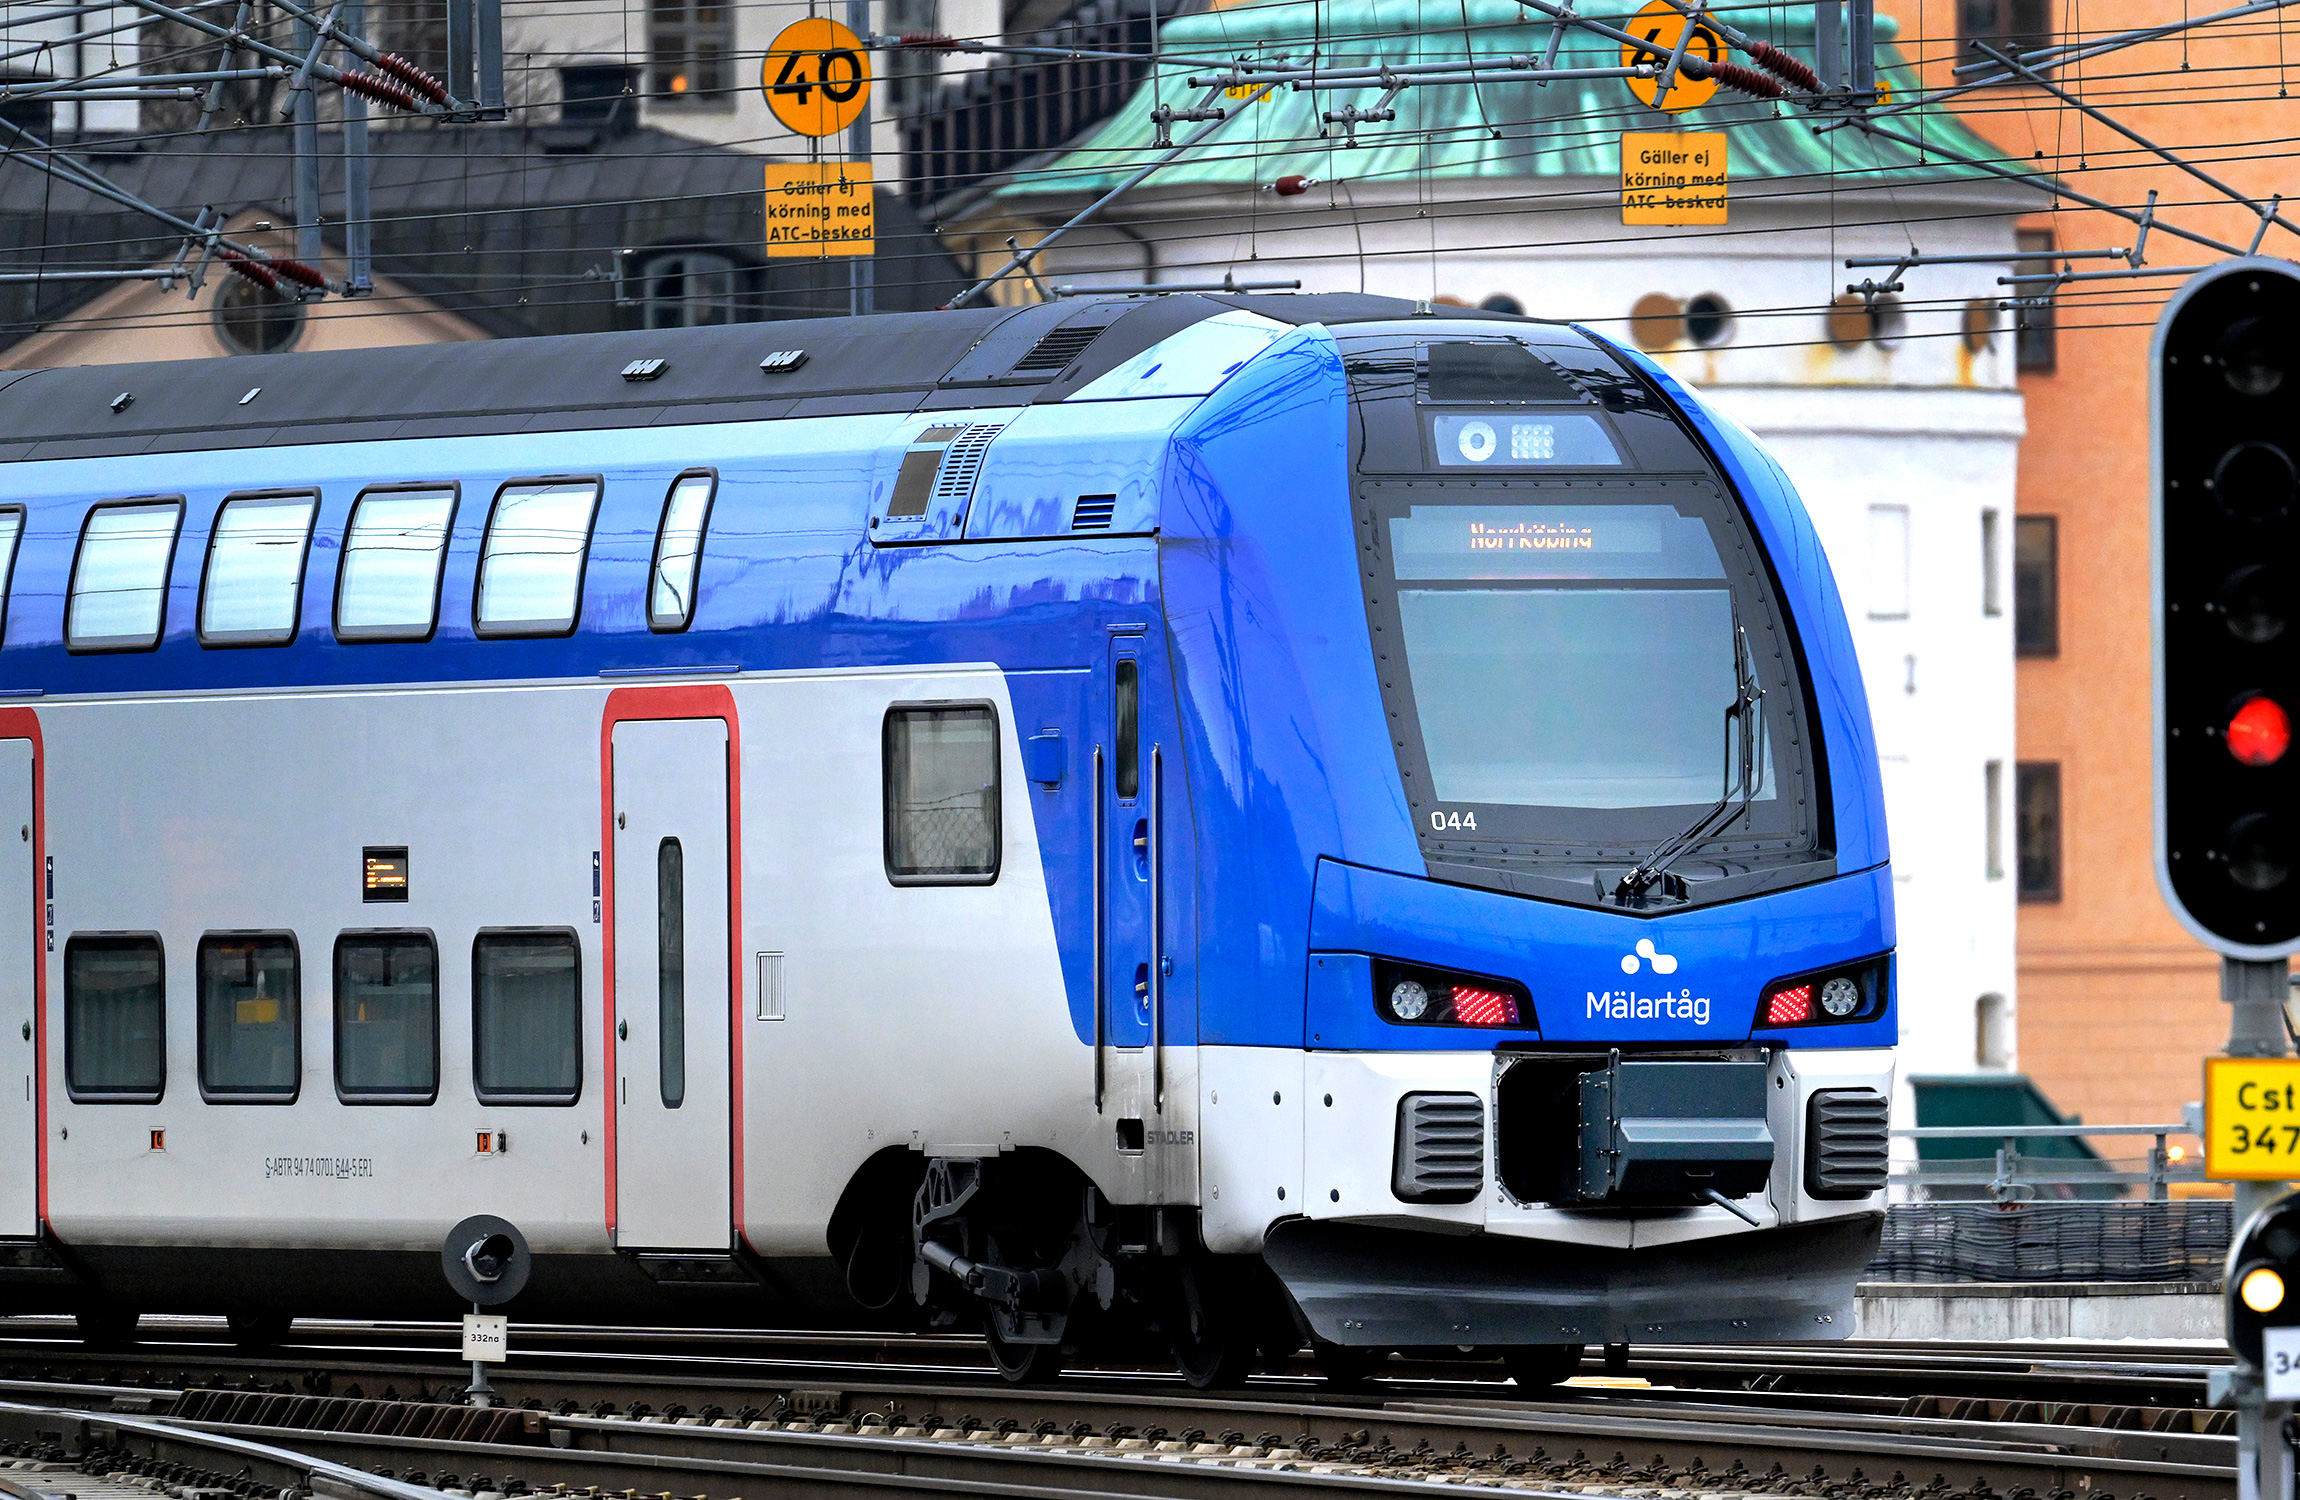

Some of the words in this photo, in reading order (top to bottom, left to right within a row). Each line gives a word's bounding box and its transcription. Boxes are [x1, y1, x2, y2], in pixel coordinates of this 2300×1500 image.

[773, 47, 862, 105] 40
[1640, 149, 1689, 164] Gäller
[1694, 149, 1709, 167] ej
[784, 181, 833, 195] Gäller
[839, 179, 854, 197] ej
[1625, 172, 1685, 190] körning
[1692, 172, 1725, 186] med
[768, 203, 830, 220] körning
[837, 202, 870, 217] med
[1626, 195, 1725, 209] ATCbesked
[770, 225, 871, 241] ATC-besked
[1470, 523, 1592, 548] Norrköping
[1430, 811, 1477, 831] 044
[1586, 988, 1710, 1026] Mälartåg
[2238, 1082, 2294, 1111] Cst
[1147, 1131, 1195, 1145] STADLER
[2231, 1124, 2300, 1154] 347
[294, 1158, 303, 1176] 94
[305, 1158, 314, 1176] 74
[315, 1158, 334, 1177] 0701
[335, 1158, 357, 1179] 644-5
[471, 1334, 499, 1342] 332na
